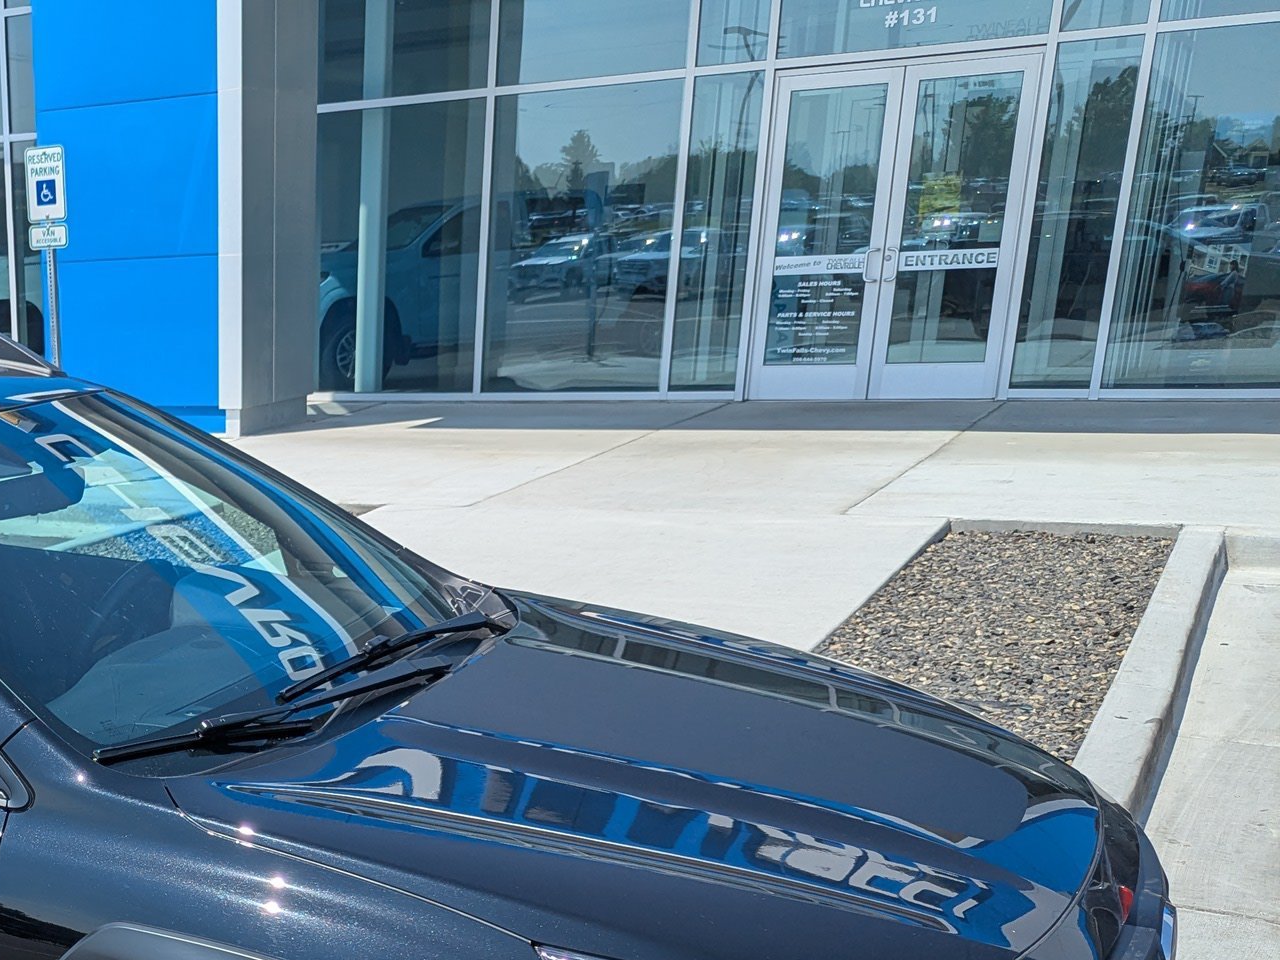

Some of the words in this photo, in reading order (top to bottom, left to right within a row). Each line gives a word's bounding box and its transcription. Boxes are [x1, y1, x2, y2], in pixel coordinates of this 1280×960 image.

[885, 6, 937, 28] #131
[28, 152, 62, 165] RESERVED
[30, 166, 60, 177] PARKING
[42, 228, 55, 237] VAN
[904, 252, 997, 267] ENTRANCE
[775, 262, 811, 271] Welcome
